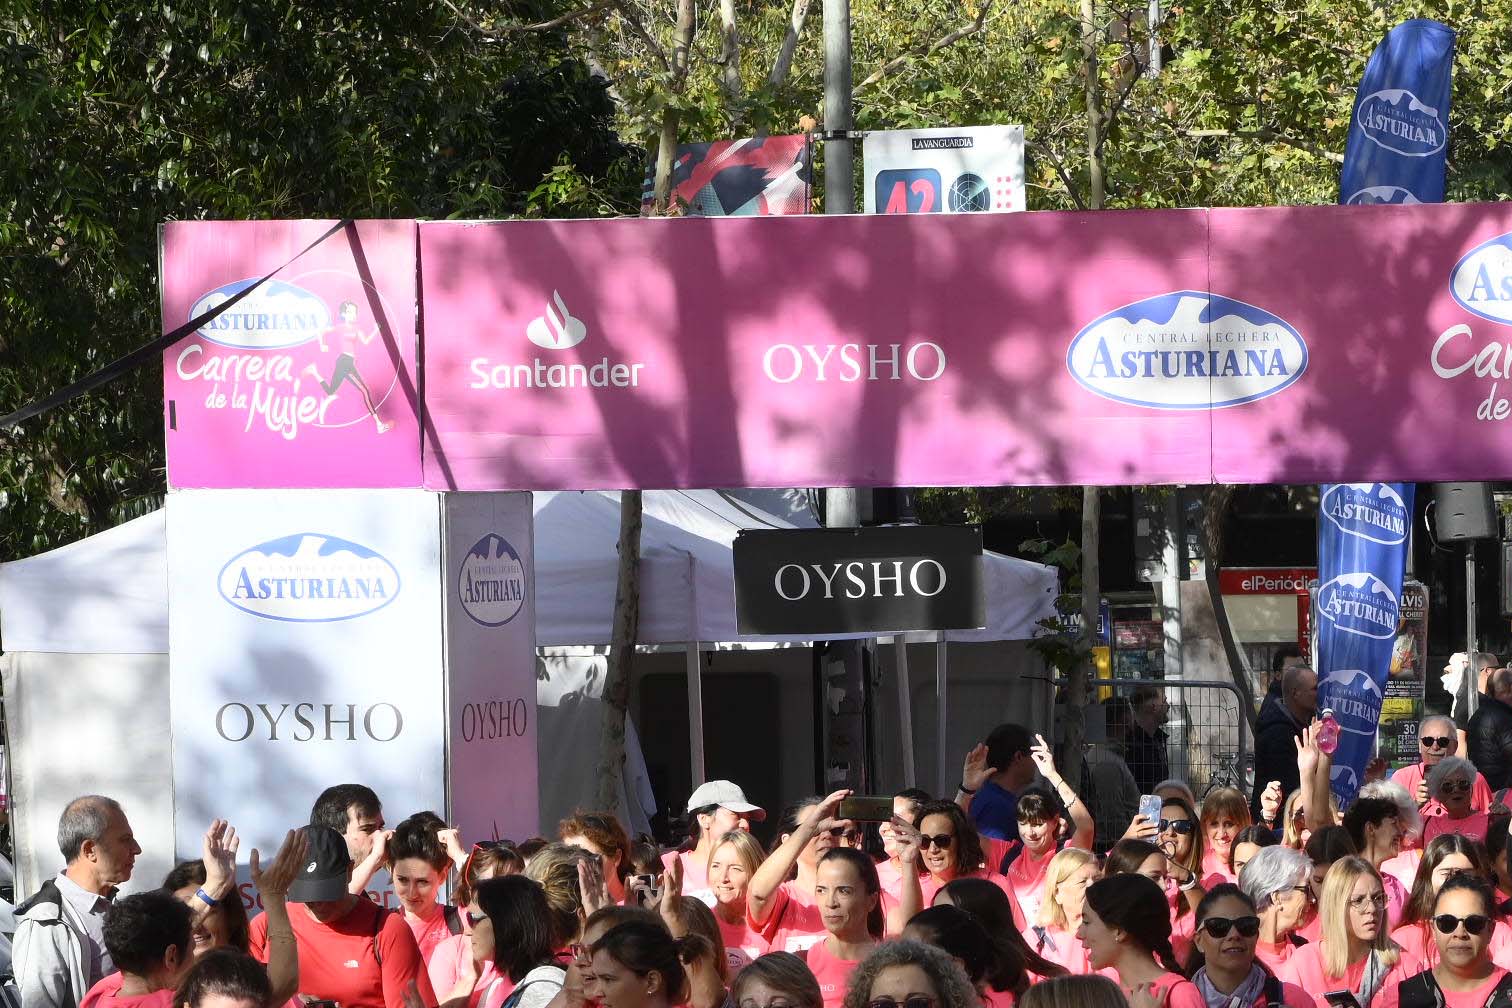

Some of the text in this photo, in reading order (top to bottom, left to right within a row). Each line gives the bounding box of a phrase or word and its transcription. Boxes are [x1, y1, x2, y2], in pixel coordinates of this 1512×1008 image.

[923, 137, 972, 148] VANGUARDIA
[1123, 331, 1280, 343] CENTRAL LECHERA
[176, 344, 293, 381] Carrera
[470, 357, 645, 389] Santander
[762, 341, 946, 384] OYSHO
[1086, 336, 1289, 379] ASTURIANA
[205, 379, 339, 441] de la Mujer
[1476, 383, 1511, 420] de
[1331, 493, 1404, 535] ASTURIANA
[232, 567, 387, 599] ASTURIANA
[464, 567, 522, 603] ASTURIANA
[774, 559, 947, 601] OYSHO
[1324, 588, 1395, 630] ASTURIANA
[215, 702, 404, 742] OYSHO
[461, 697, 528, 743] OYSHO
